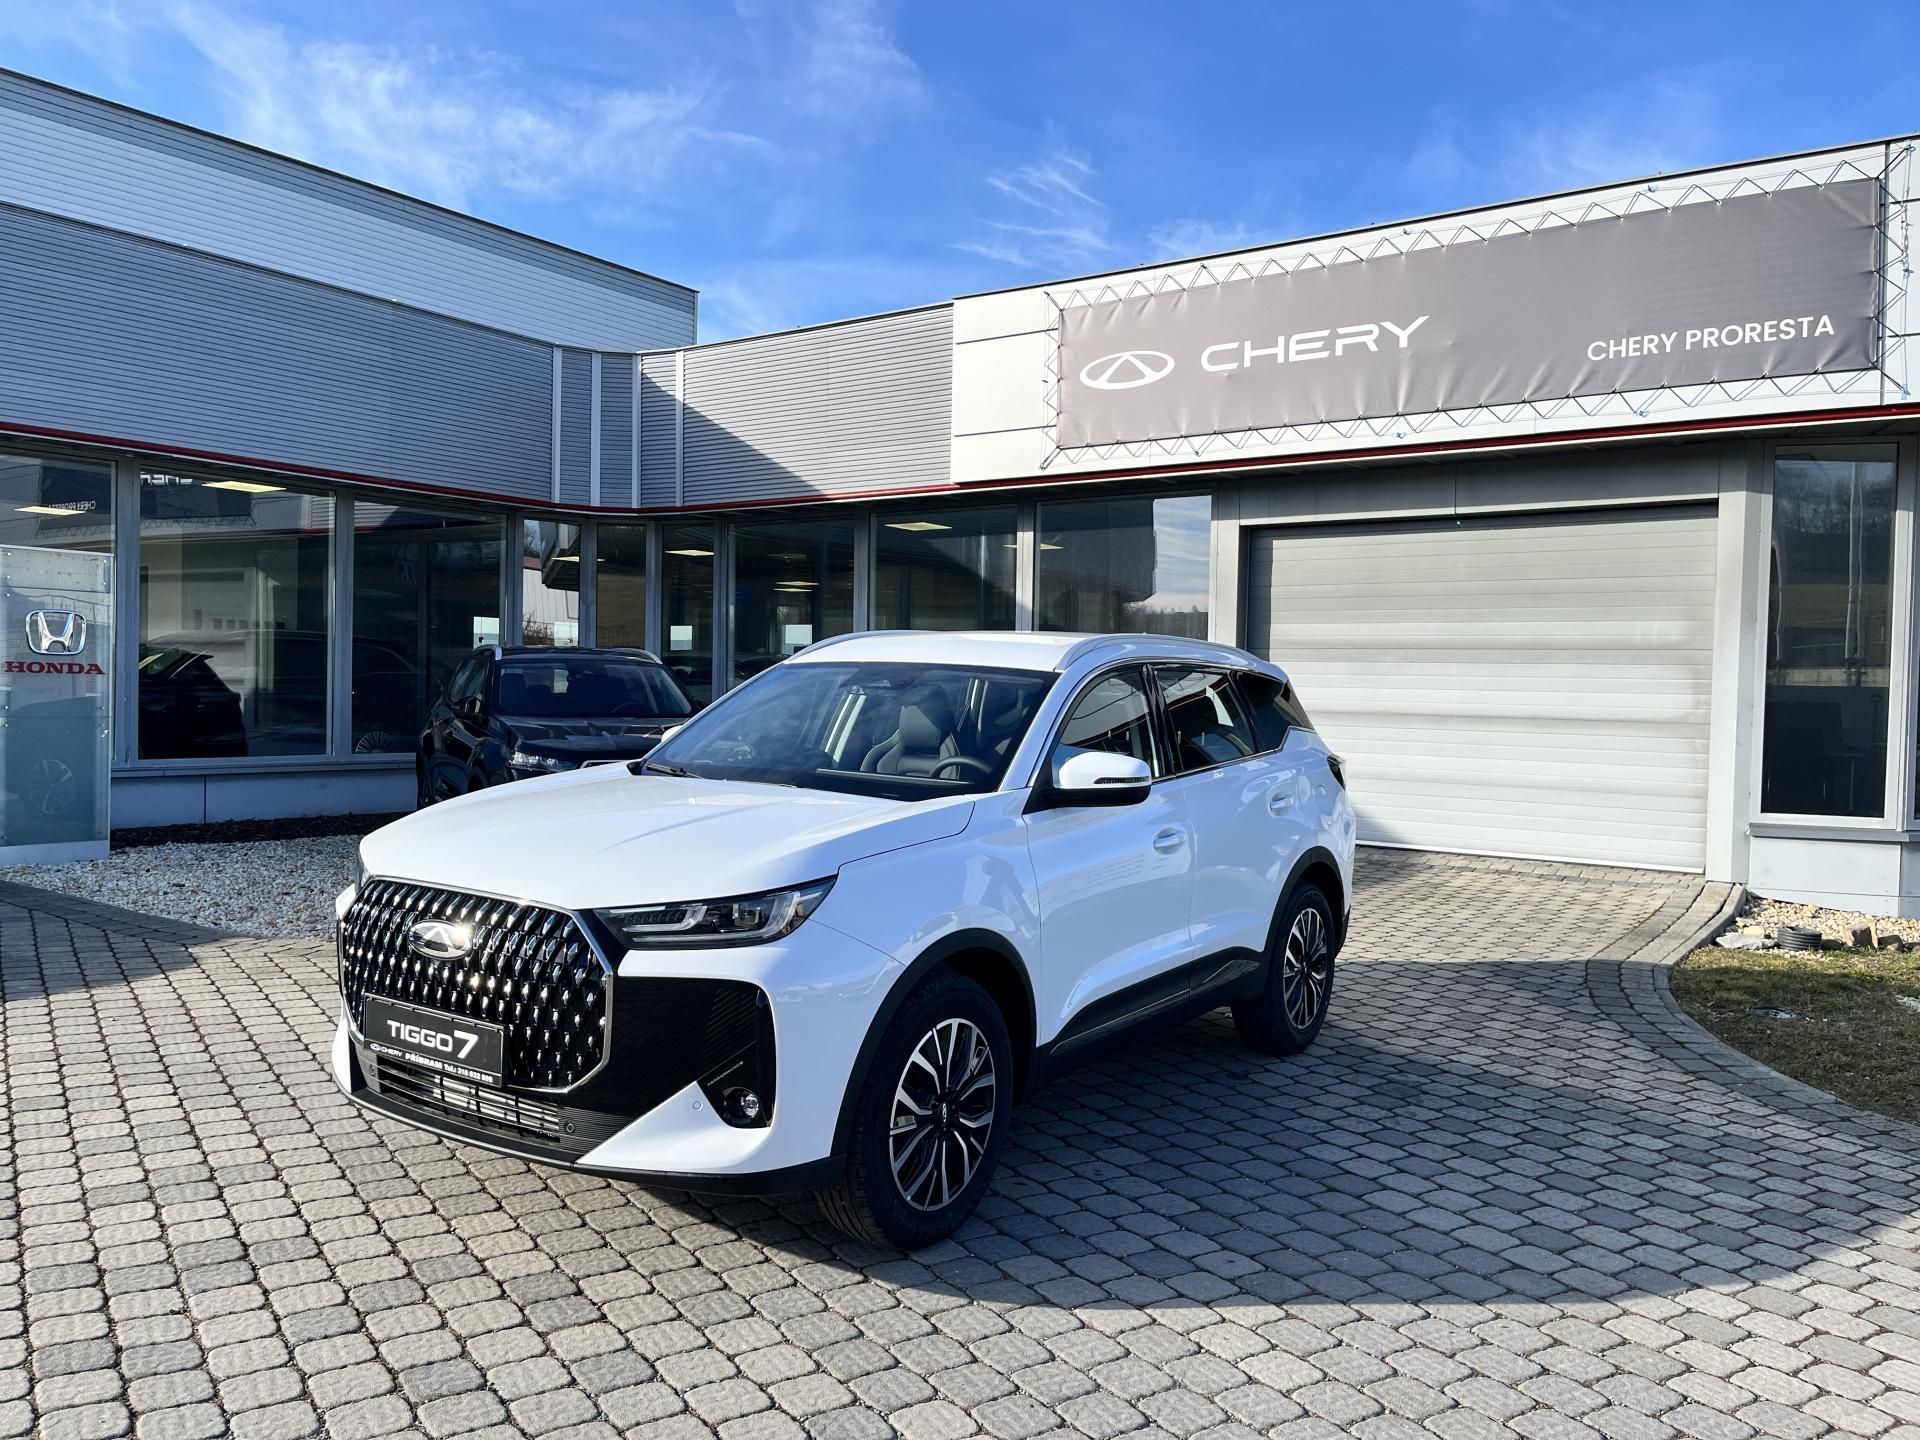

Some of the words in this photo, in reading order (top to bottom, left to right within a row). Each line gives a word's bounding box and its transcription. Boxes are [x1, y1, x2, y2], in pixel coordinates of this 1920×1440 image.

[1200, 315, 1430, 373] CHERY
[1587, 331, 1678, 361] CHERY
[1685, 314, 1835, 351] PRORESTA
[4, 660, 106, 675] HONDA
